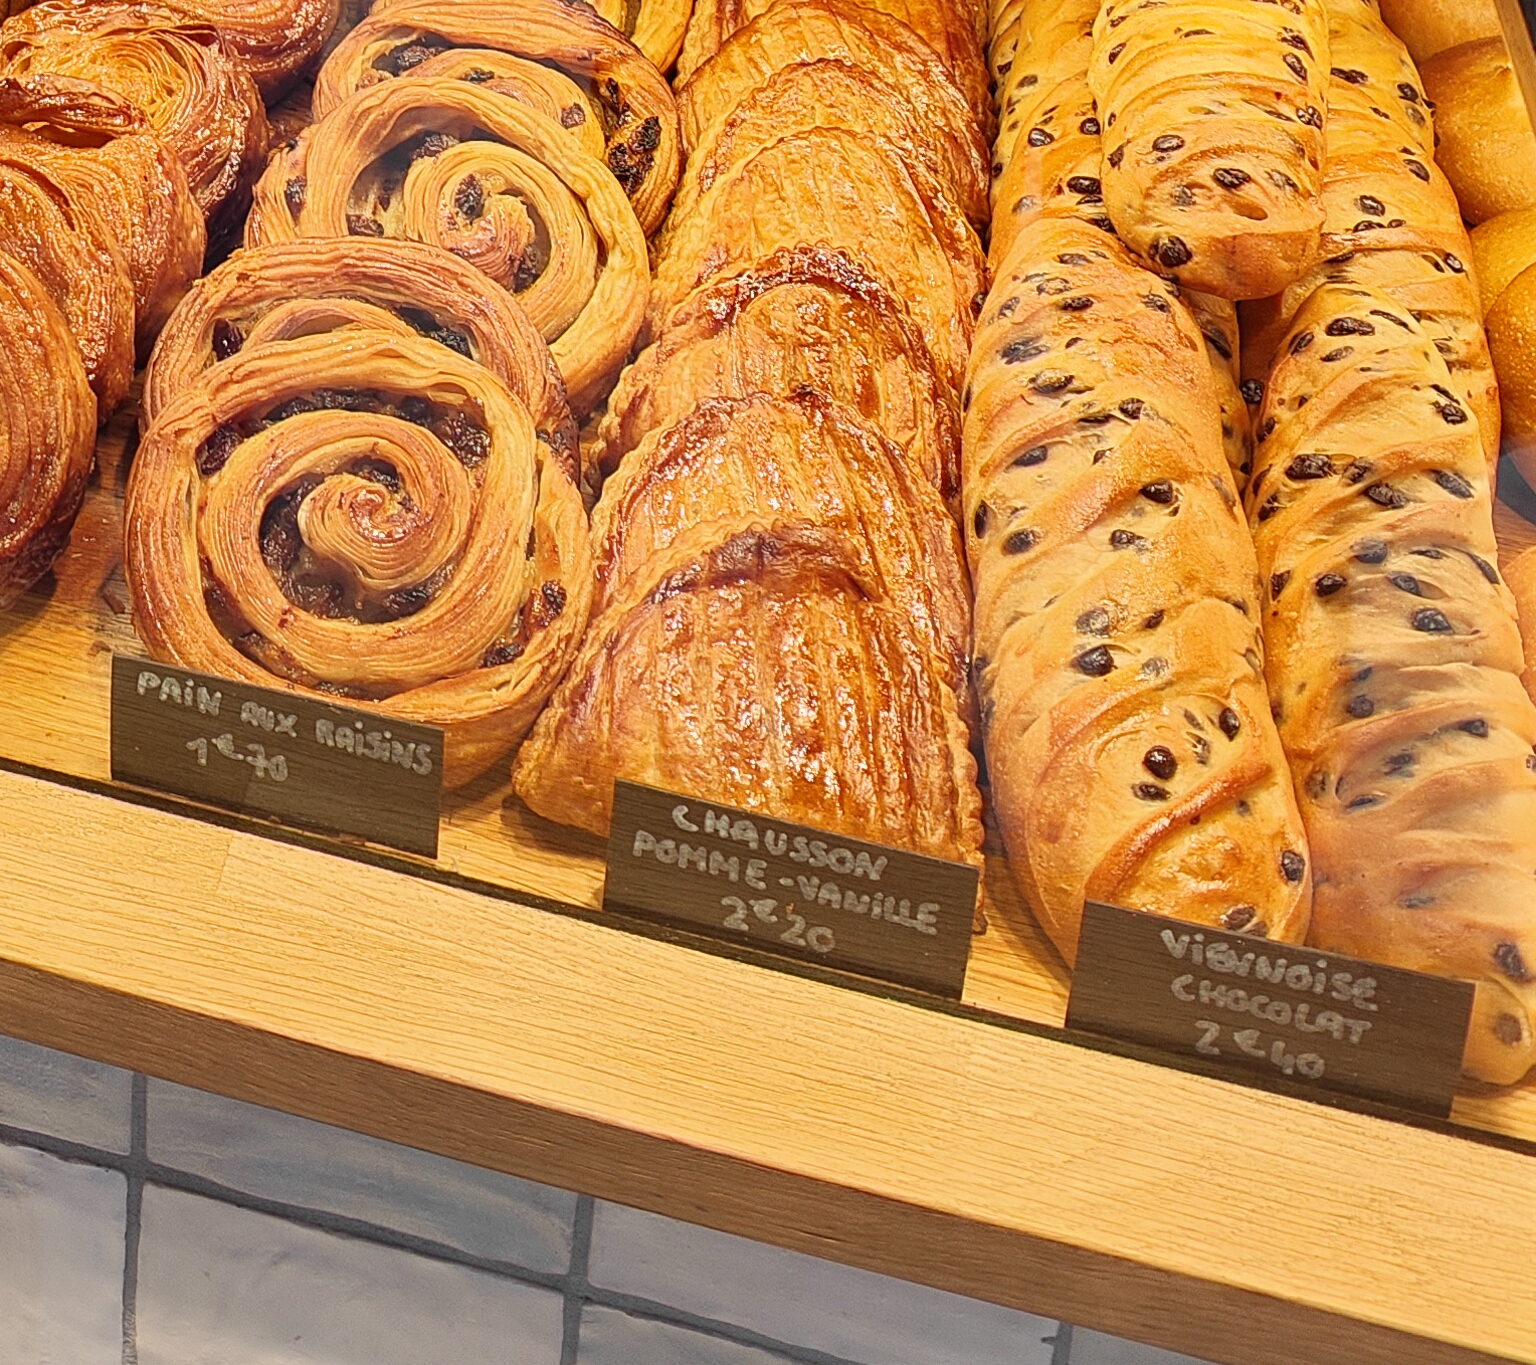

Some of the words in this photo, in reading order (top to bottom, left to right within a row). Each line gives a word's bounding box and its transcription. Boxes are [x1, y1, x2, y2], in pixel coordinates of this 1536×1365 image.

[239, 700, 299, 739] AUX
[671, 803, 889, 882] CHAUSSON
[1170, 973, 1374, 1045] CHOCOLAT
